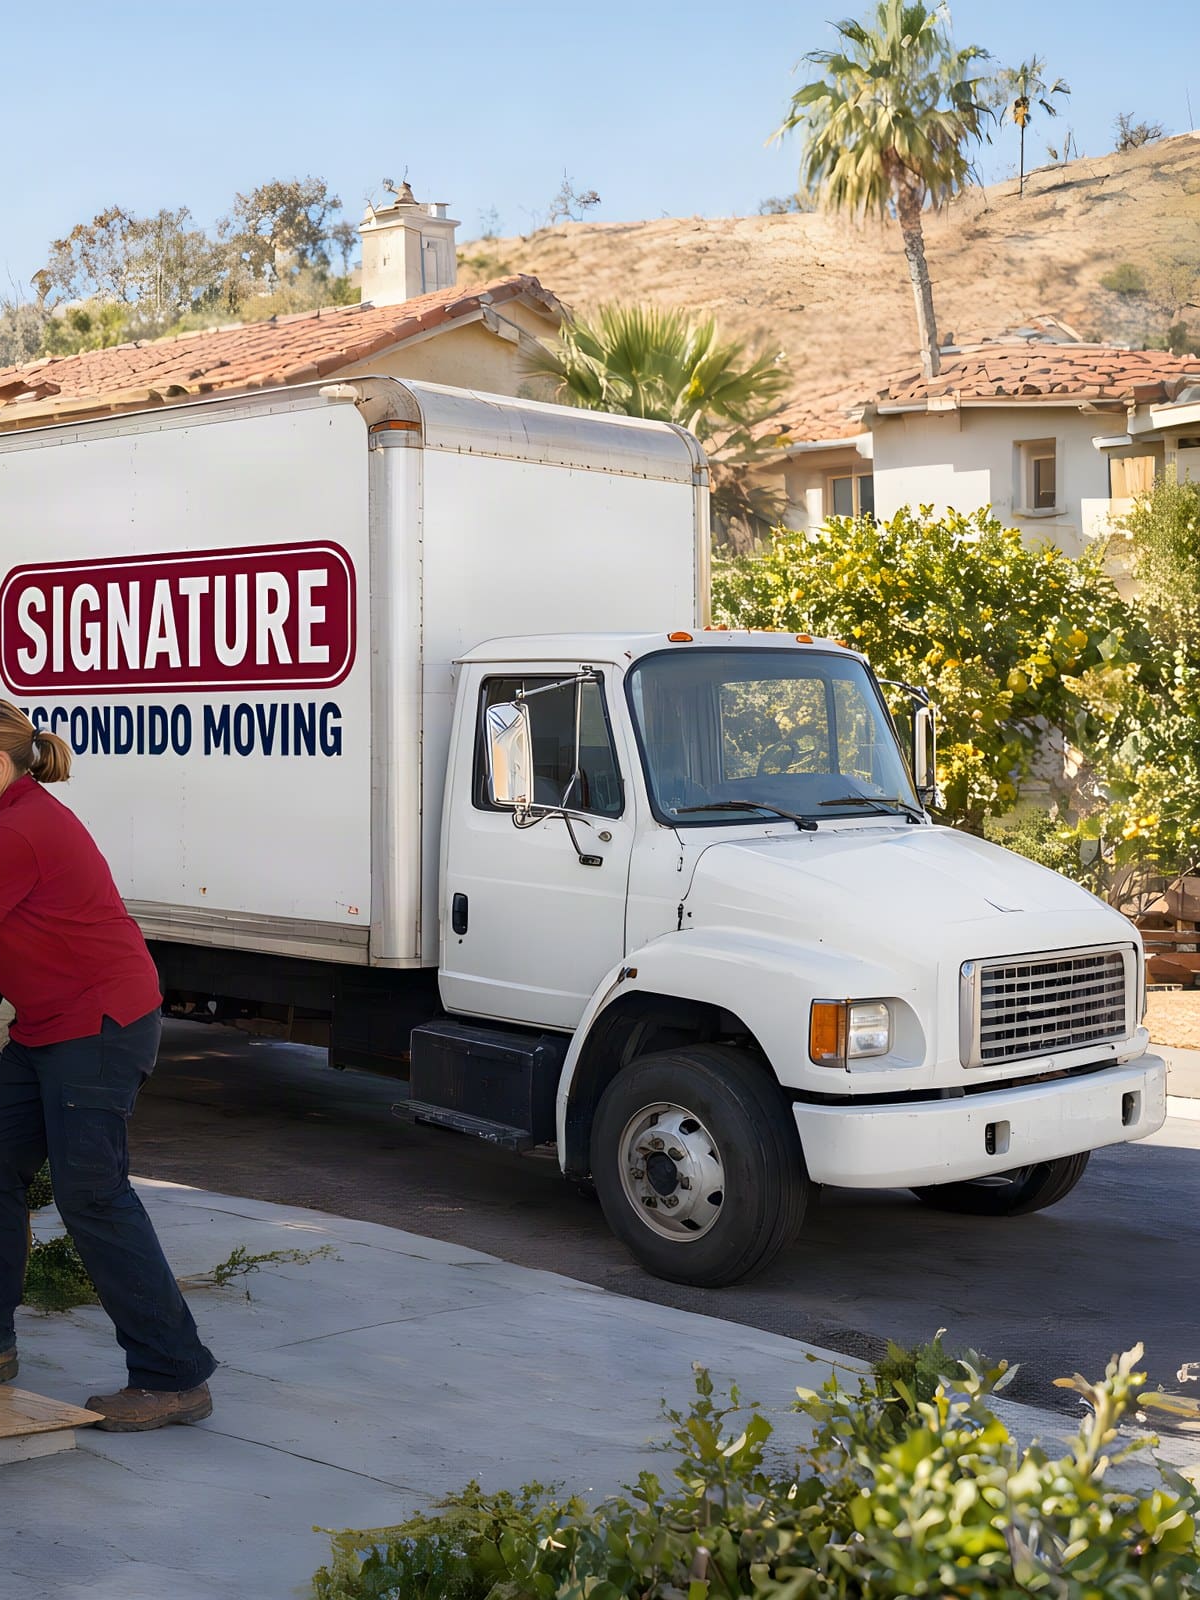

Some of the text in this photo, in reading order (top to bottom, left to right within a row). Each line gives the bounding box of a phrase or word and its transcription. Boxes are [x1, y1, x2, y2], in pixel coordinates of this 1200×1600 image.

[17, 568, 330, 675] SIGNATURE
[19, 702, 342, 757] CONDIDO MOVING
